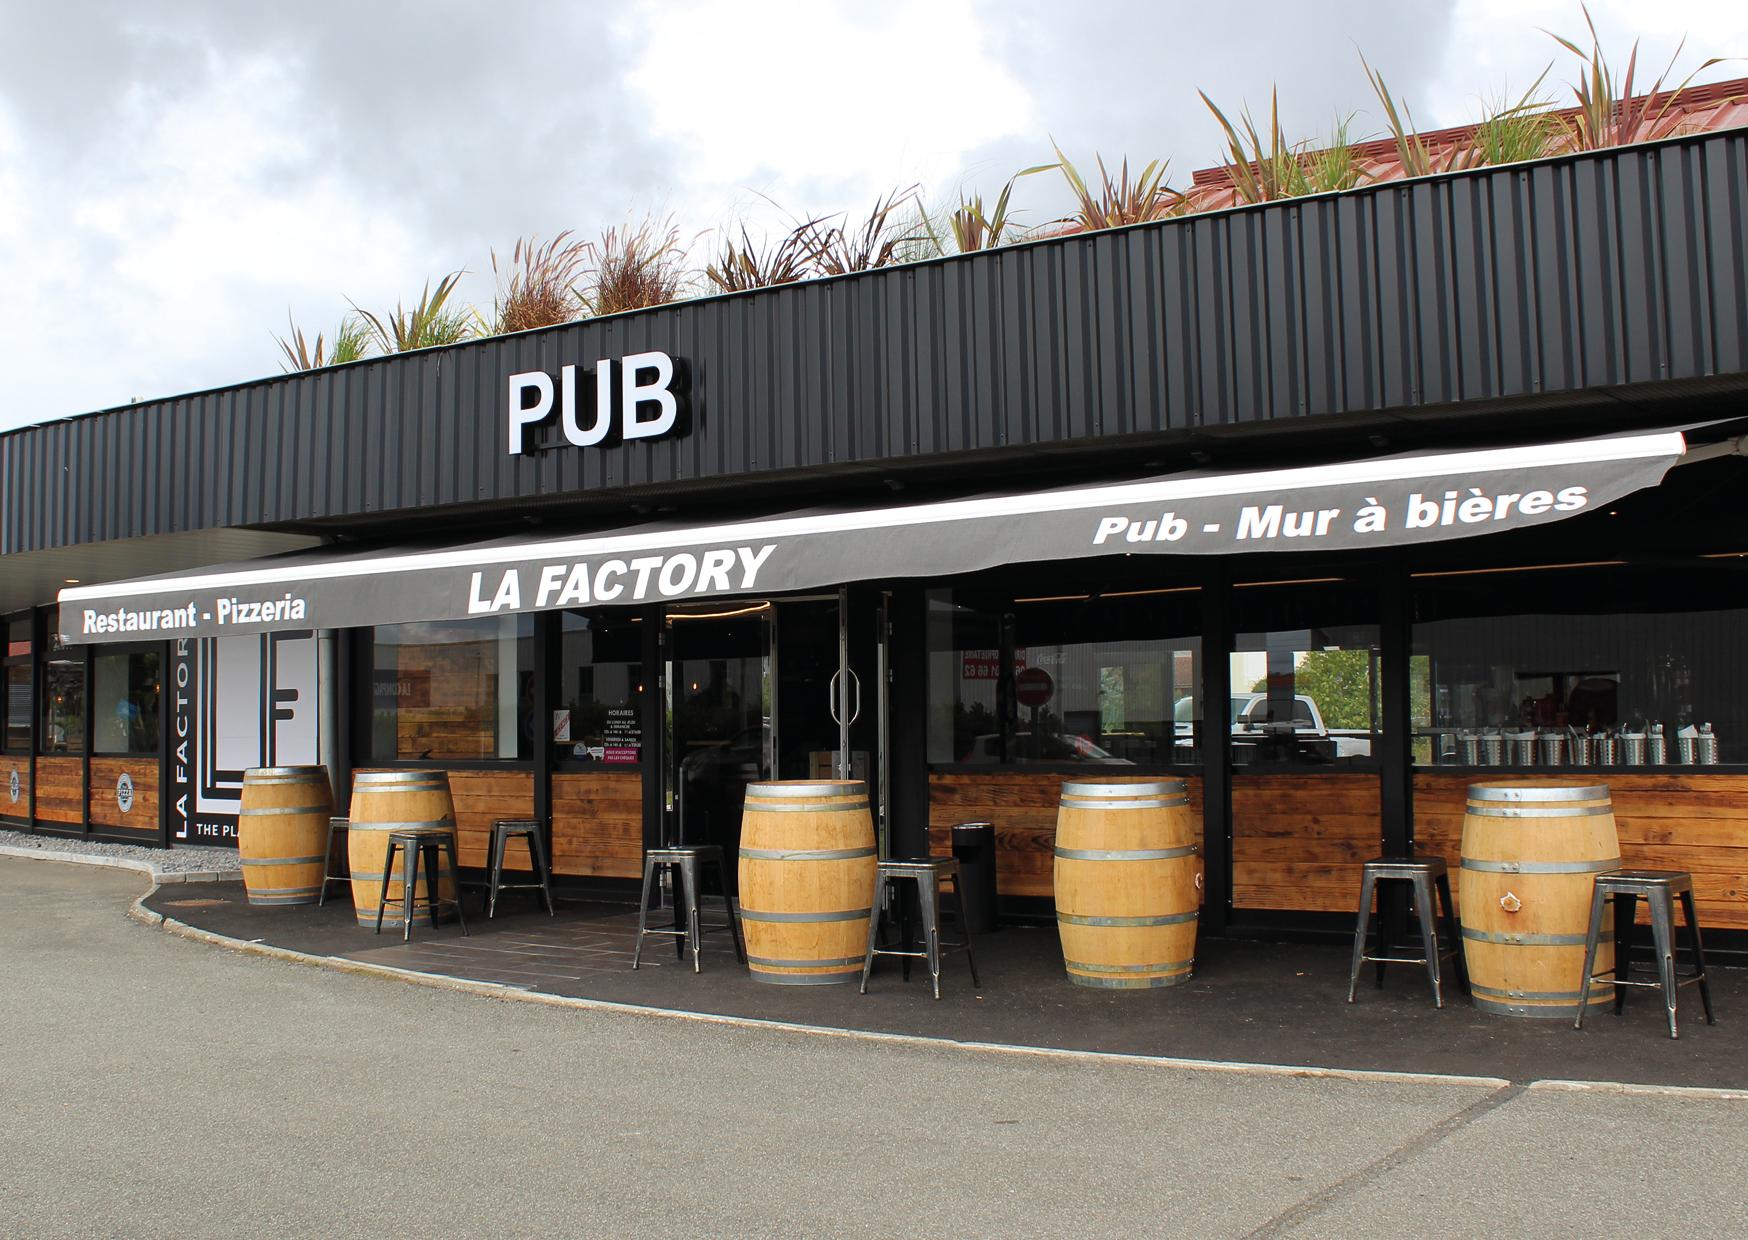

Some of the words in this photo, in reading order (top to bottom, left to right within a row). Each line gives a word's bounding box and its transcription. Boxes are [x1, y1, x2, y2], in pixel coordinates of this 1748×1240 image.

[509, 351, 677, 455] PUB
[1092, 512, 1188, 545] Pub
[1203, 523, 1220, 533] -
[1236, 504, 1339, 540] Mur
[1353, 497, 1386, 533] à
[1405, 485, 1588, 529] bières
[467, 569, 521, 614] LA
[535, 544, 778, 607] FACTORY
[83, 601, 197, 634] Restaurant
[203, 612, 211, 620] -
[217, 593, 306, 625] Pizzeria
[176, 793, 188, 839] LA
[196, 823, 219, 836] THE
